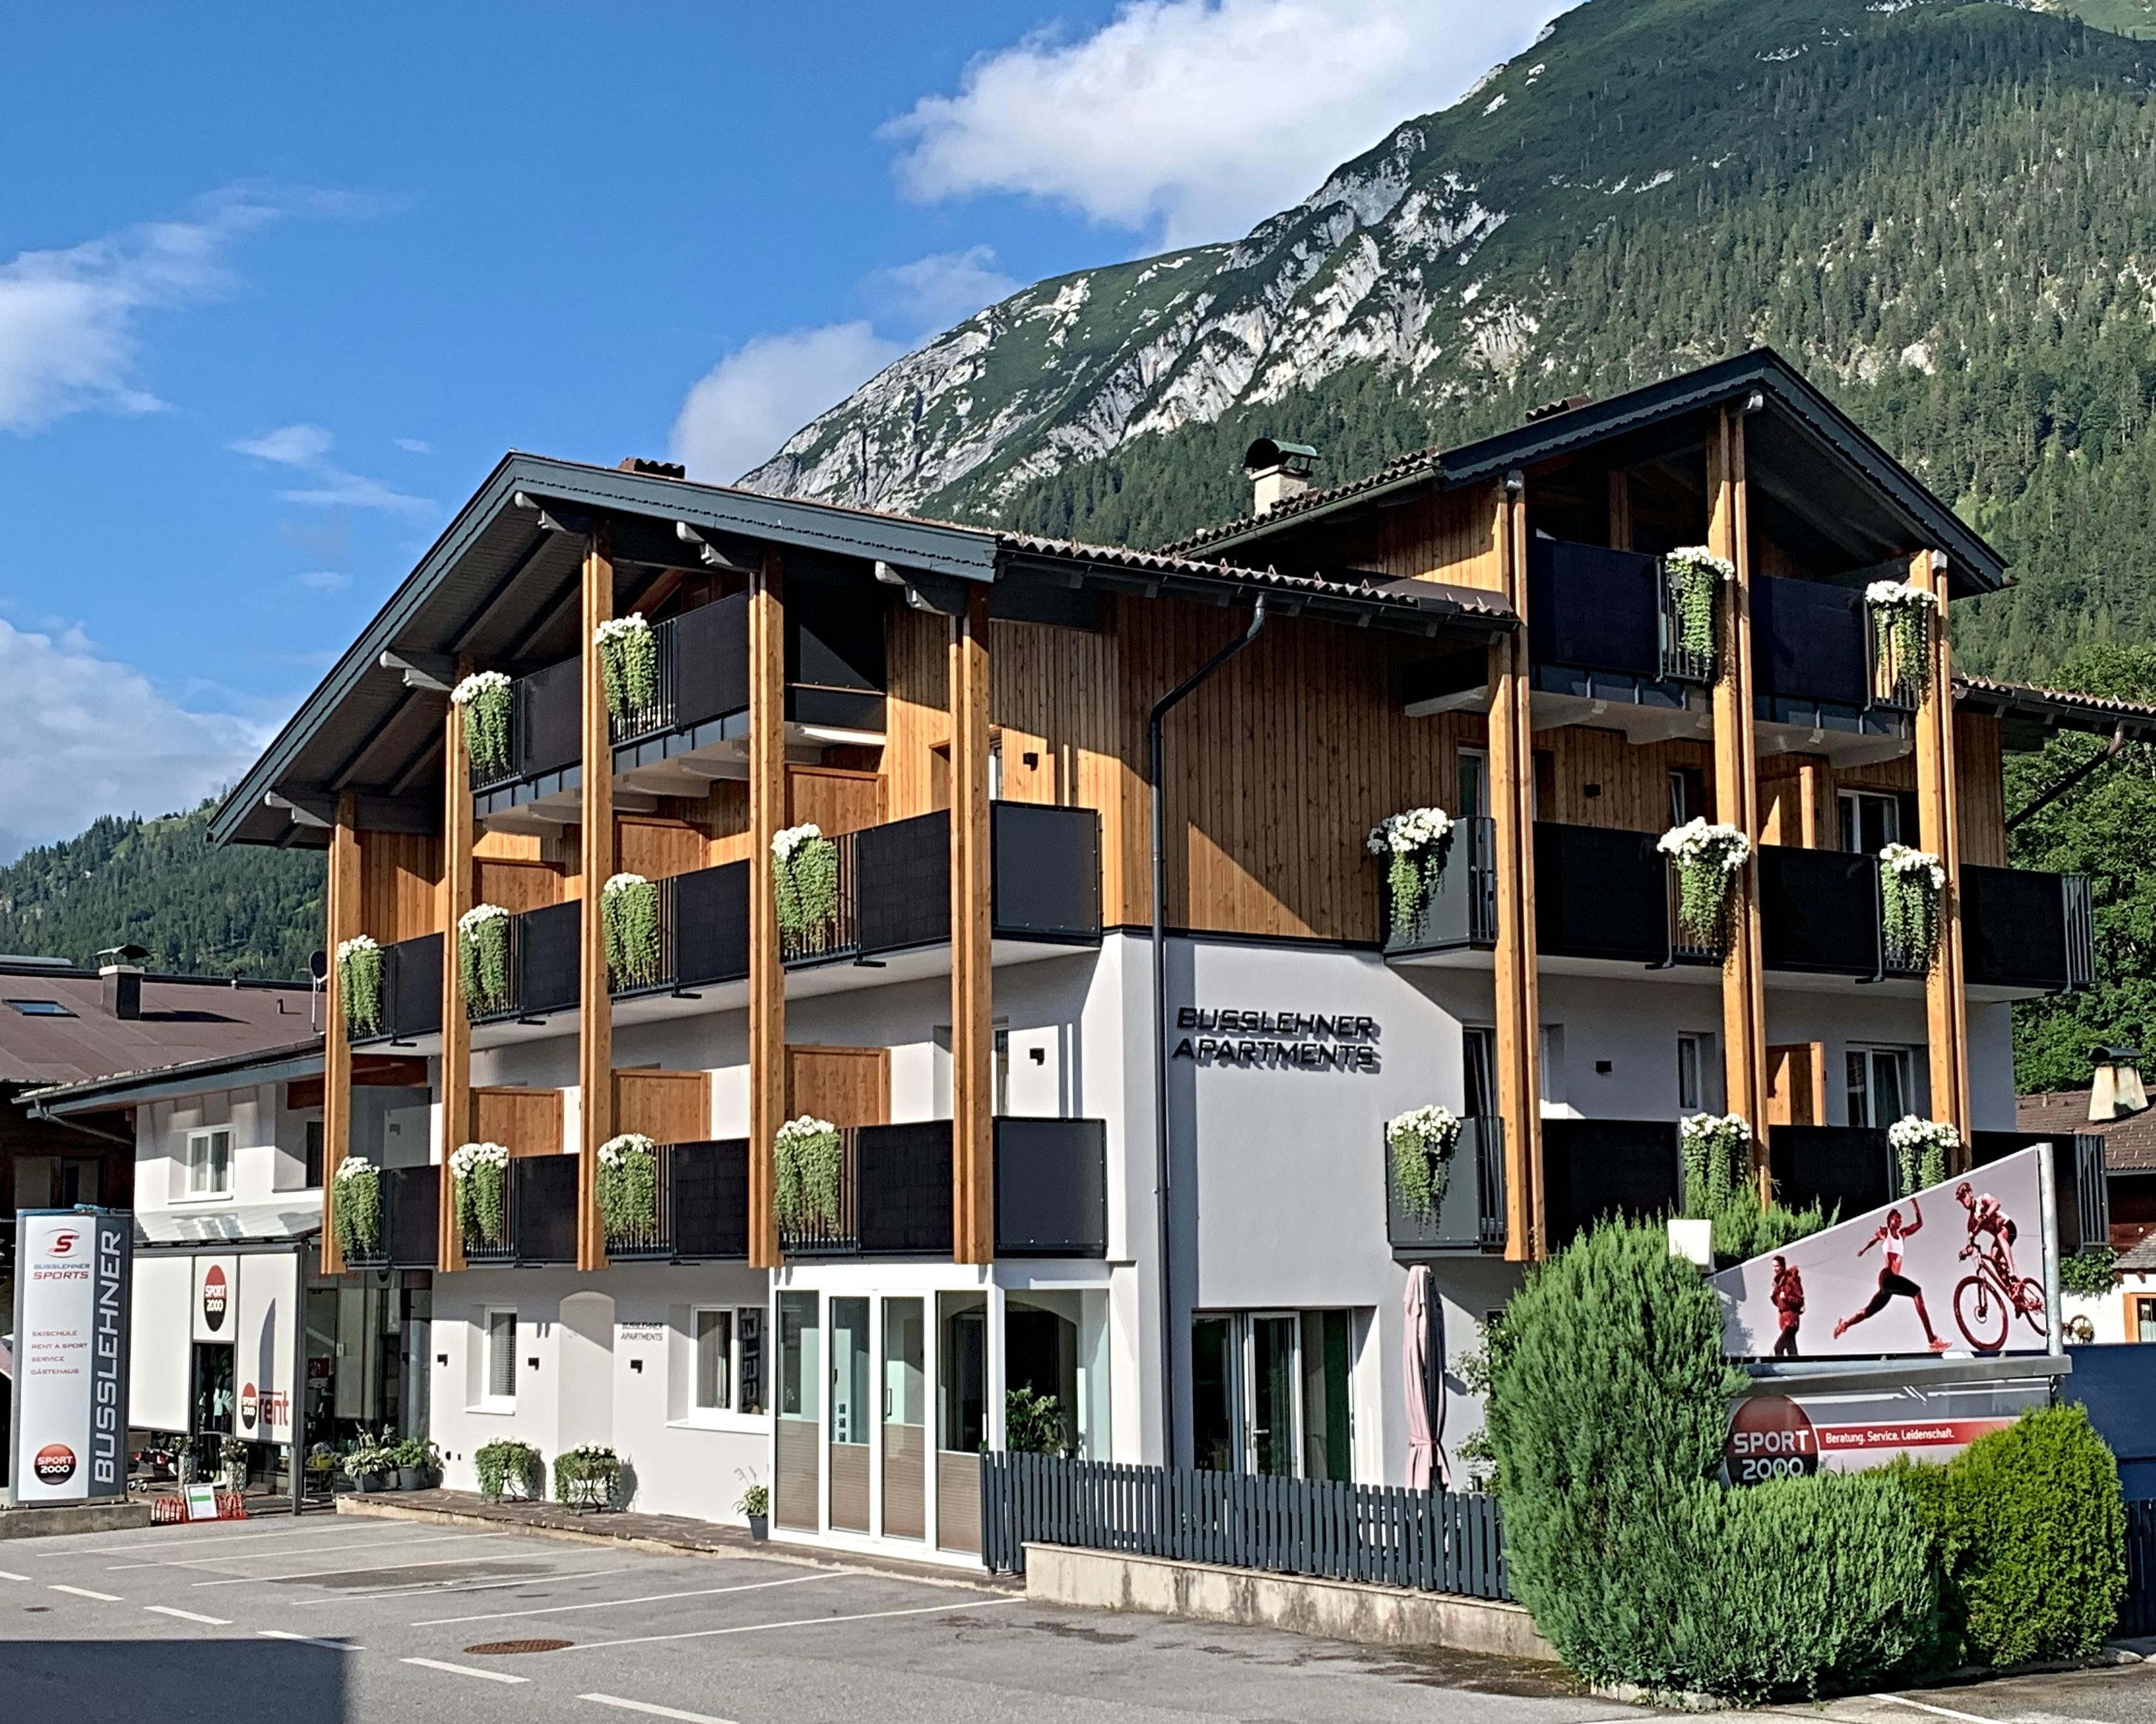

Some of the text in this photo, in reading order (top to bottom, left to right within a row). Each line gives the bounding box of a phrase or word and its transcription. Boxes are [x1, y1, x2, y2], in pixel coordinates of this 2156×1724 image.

[1176, 1006, 1374, 1038] BUSSLEHNER
[1172, 1038, 1375, 1066] APARTMENTS
[33, 1271, 89, 1280] SPORTS
[205, 1284, 226, 1297] SPORT
[206, 1299, 224, 1312] 2000
[621, 1332, 664, 1341] APARTMENTS
[94, 1230, 121, 1484] BUSSLEHNER
[242, 1396, 257, 1407] SPORT
[259, 1390, 288, 1426] rent
[1733, 1430, 1810, 1453] SPORT
[1825, 1427, 1955, 1445] Beratung. Service. Leidenschaft.
[37, 1455, 73, 1466] SPORT
[1742, 1456, 1805, 1480] 2000
[40, 1465, 70, 1474] 2000
